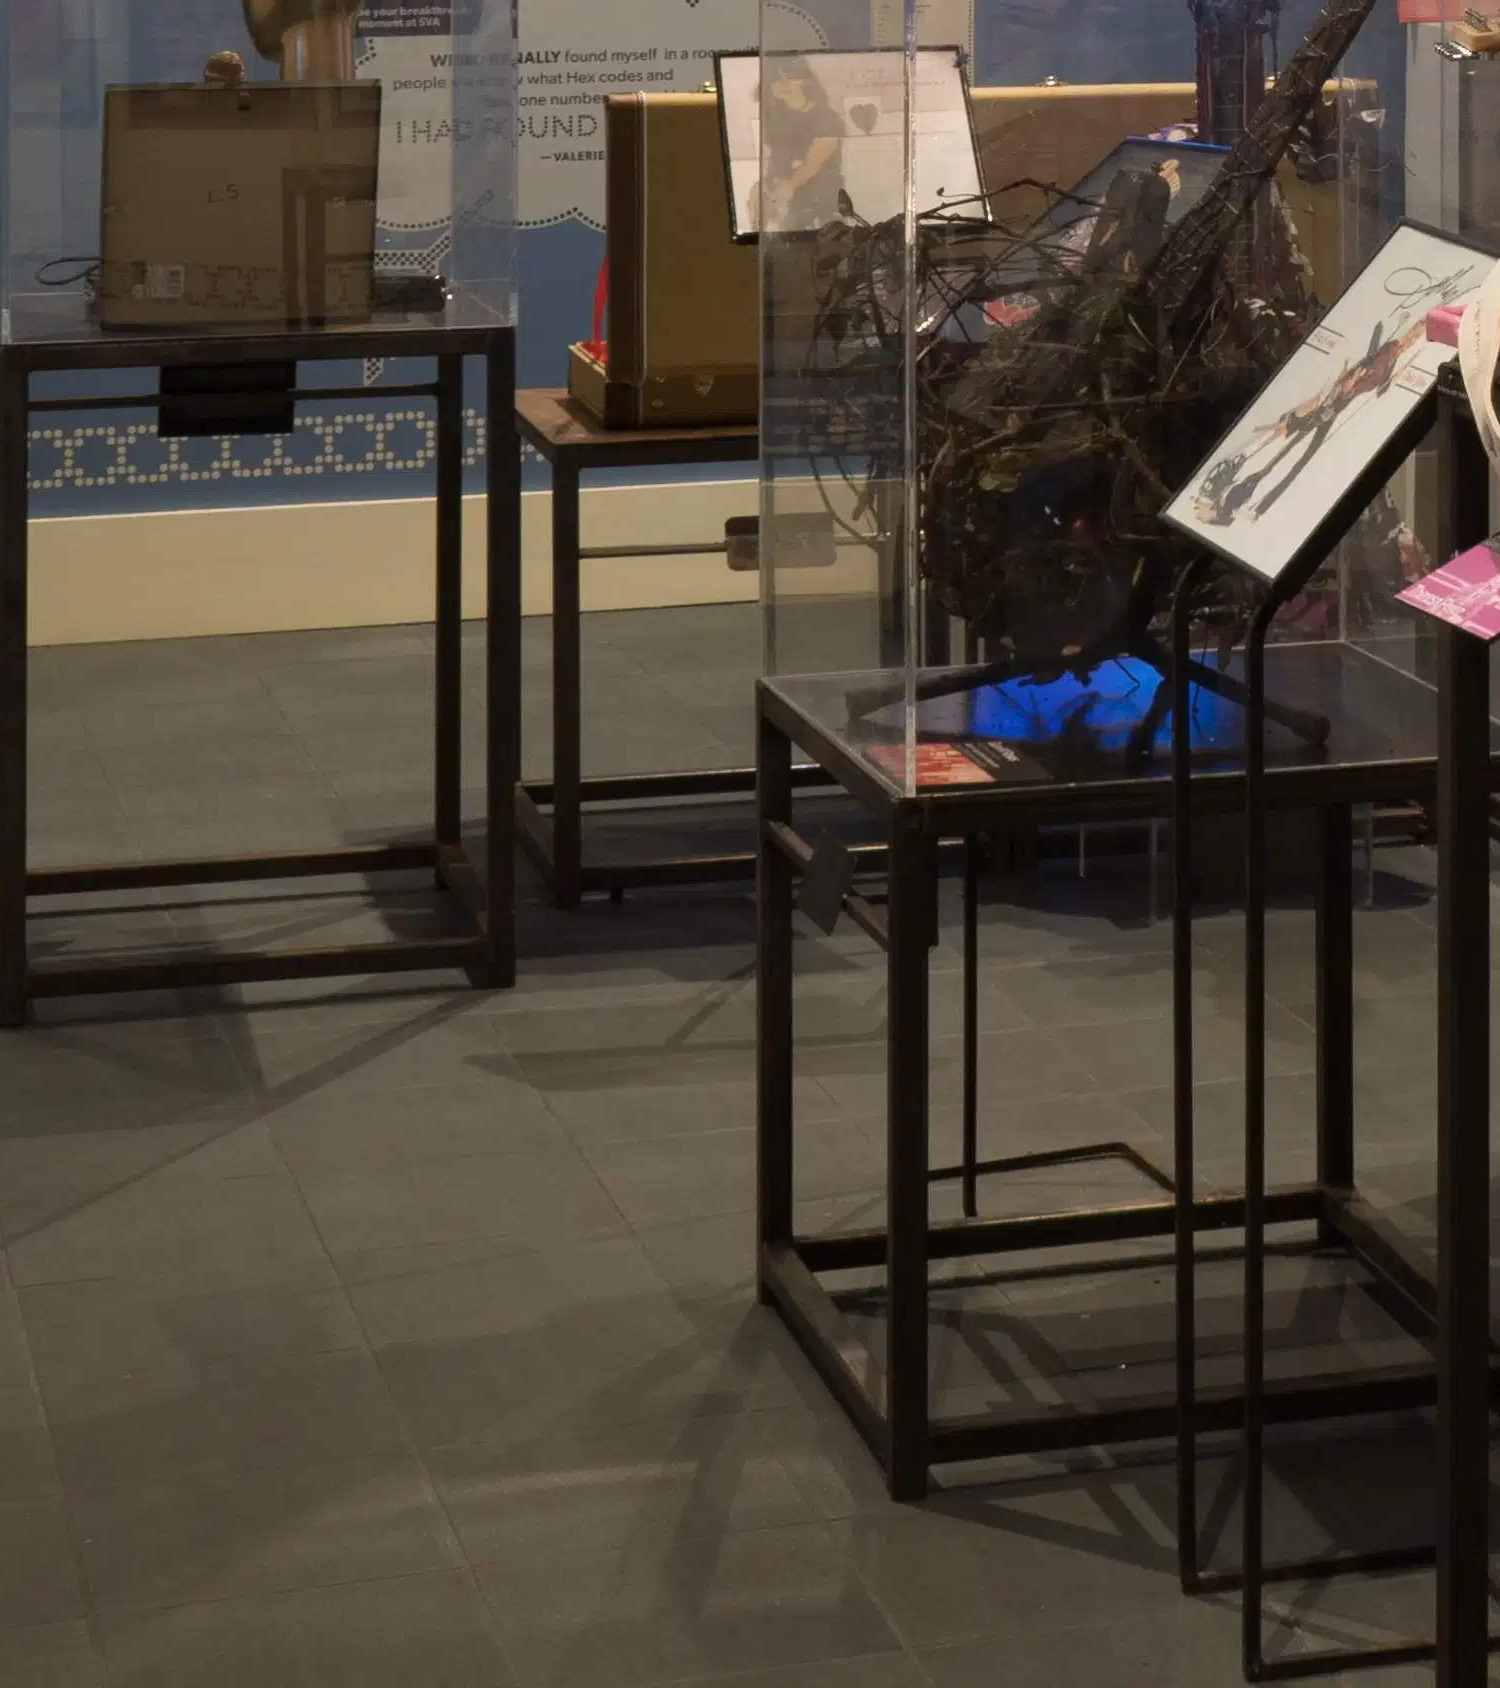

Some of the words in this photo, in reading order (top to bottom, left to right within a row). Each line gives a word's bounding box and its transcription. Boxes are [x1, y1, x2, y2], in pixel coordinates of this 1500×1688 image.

[373, 7, 398, 18] your
[358, 18, 398, 29] moment
[418, 15, 441, 28] SVA
[564, 47, 607, 63] found
[611, 47, 657, 66] myself
[664, 47, 676, 60] in
[679, 50, 689, 60] a
[393, 74, 447, 93] people
[527, 69, 563, 86] what
[566, 69, 595, 84] Hex
[599, 68, 643, 84] codes
[647, 67, 674, 82] and
[519, 94, 547, 107] one
